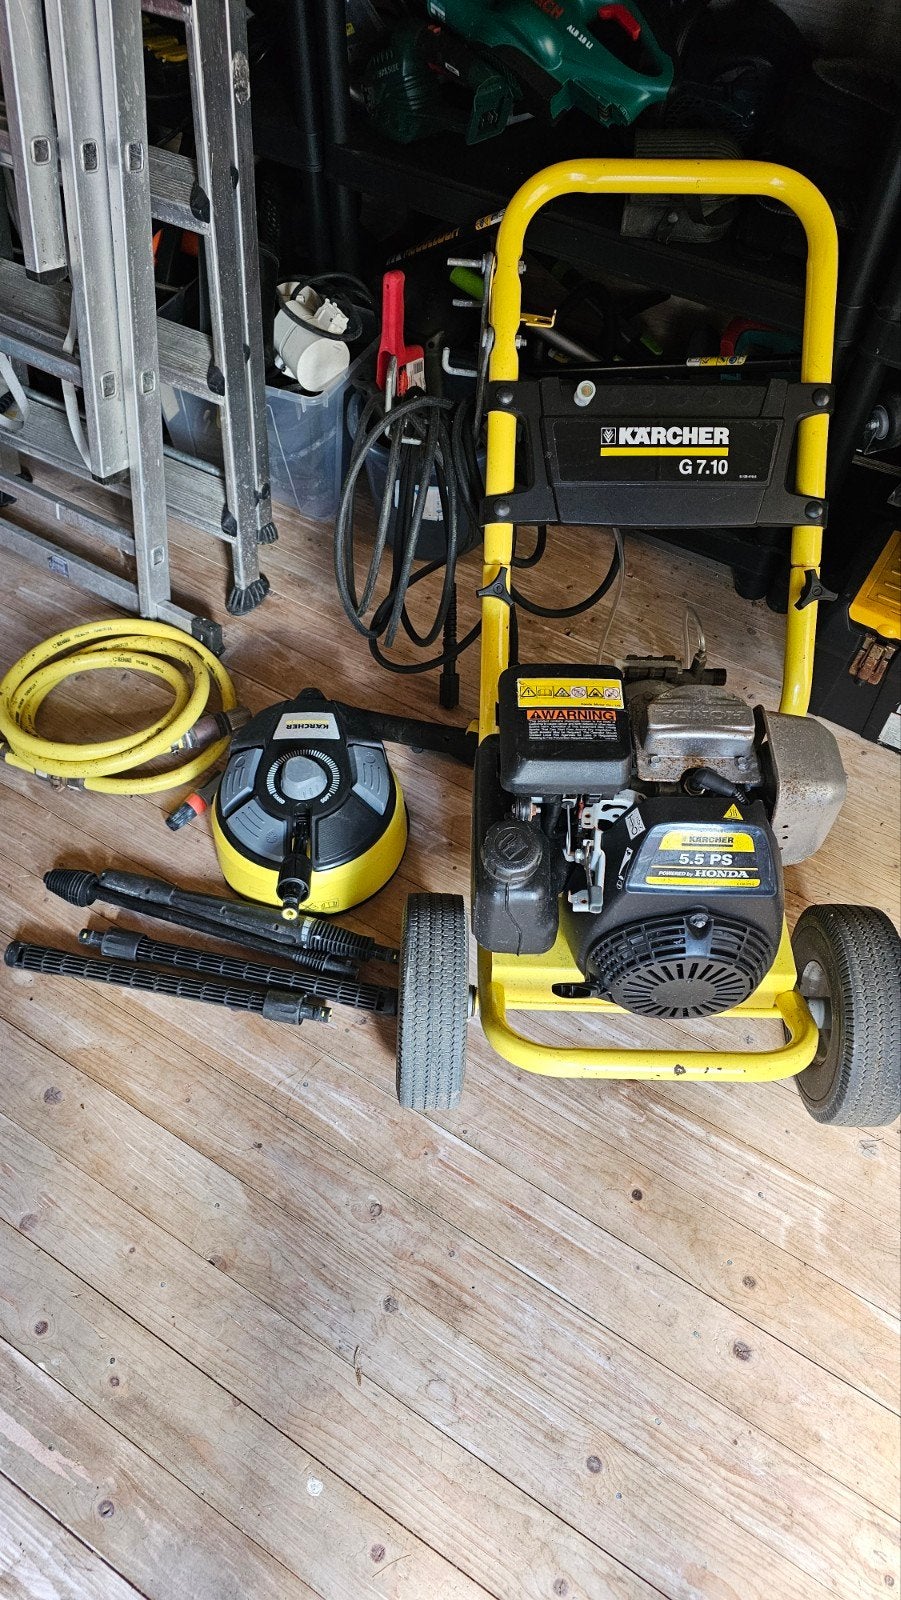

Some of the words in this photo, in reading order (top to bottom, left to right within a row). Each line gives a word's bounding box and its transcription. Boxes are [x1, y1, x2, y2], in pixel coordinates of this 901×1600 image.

[618, 426, 730, 445] KÄRCHER
[678, 458, 692, 475] G
[696, 460, 728, 475] 7.10
[542, 710, 614, 720] WARNING
[678, 854, 704, 865] 5.5
[710, 854, 733, 866] PS
[694, 870, 749, 878] HONDA
